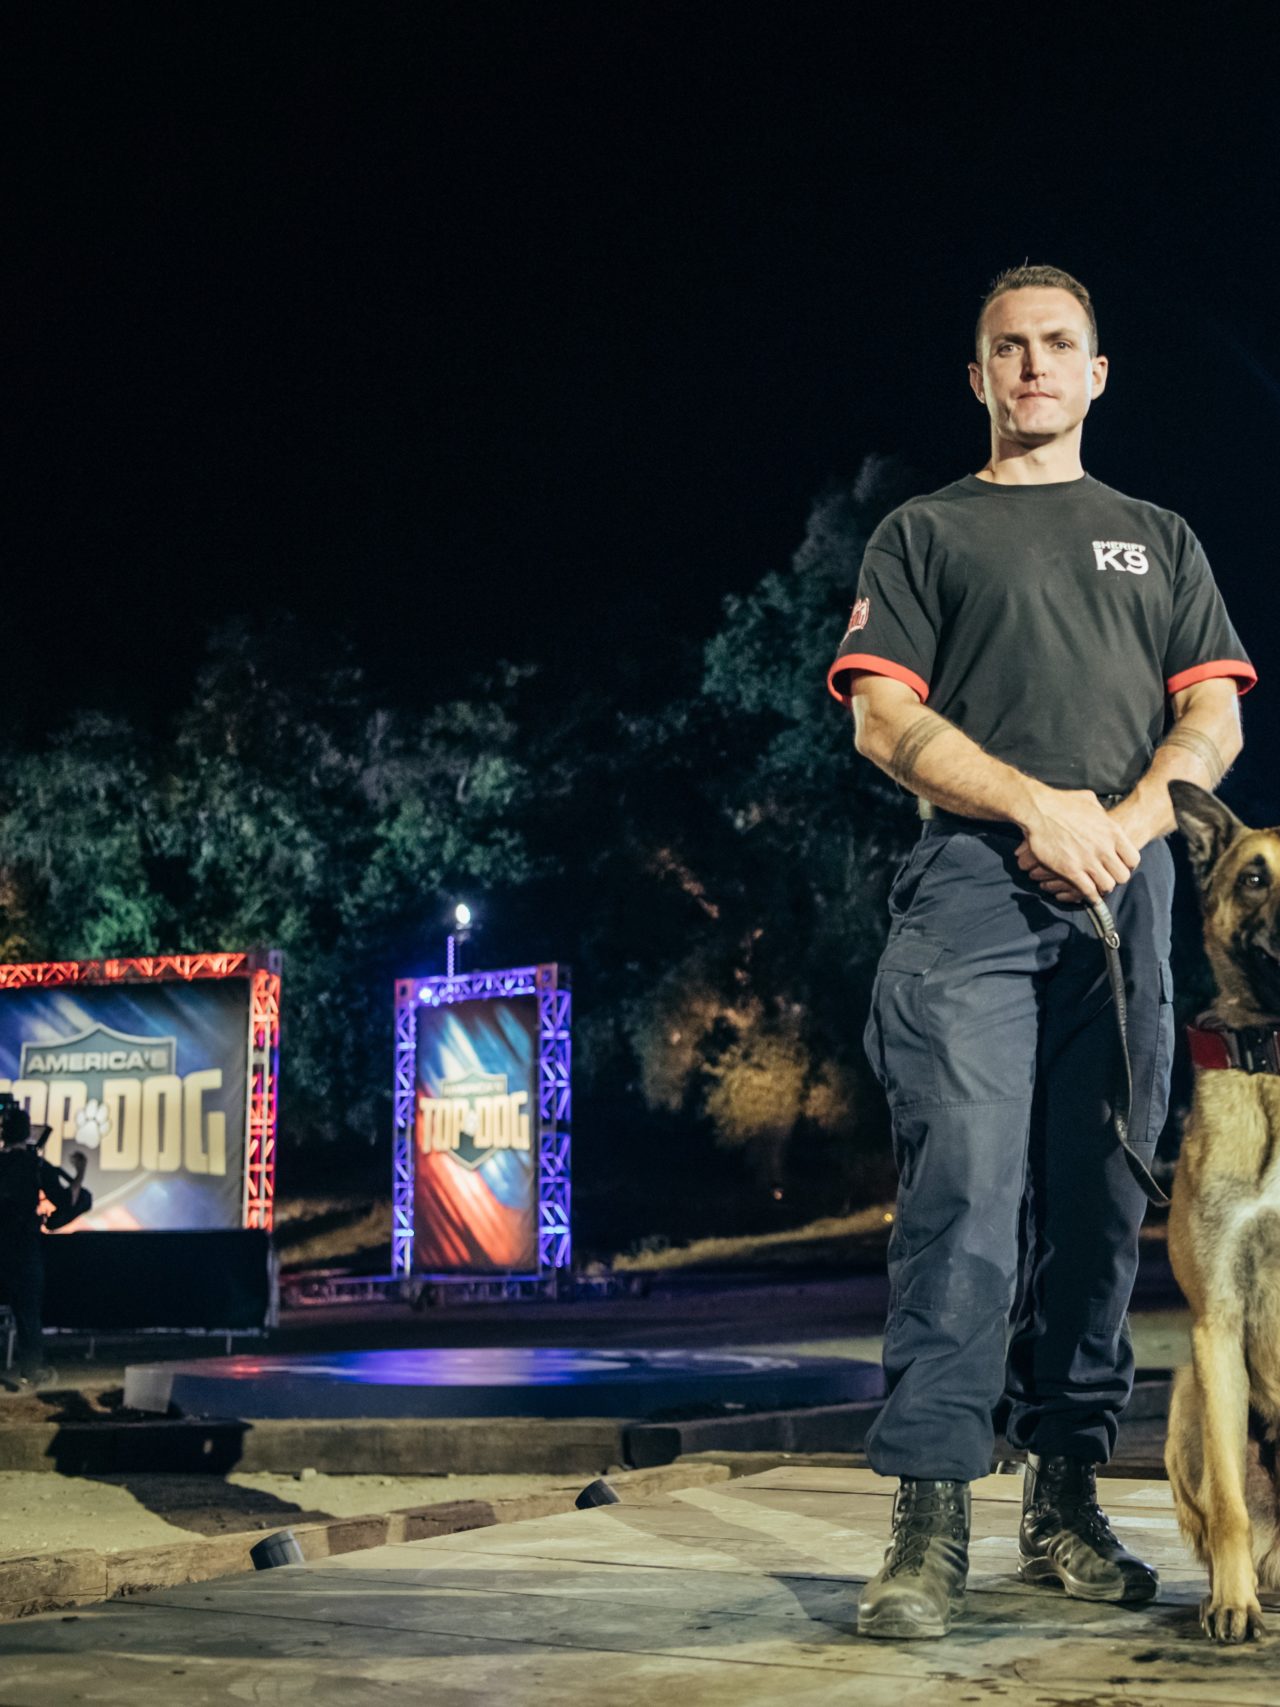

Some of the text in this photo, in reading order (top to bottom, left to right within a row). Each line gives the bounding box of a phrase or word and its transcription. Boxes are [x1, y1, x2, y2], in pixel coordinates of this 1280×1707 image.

[1093, 549, 1149, 575] K9
[26, 1050, 169, 1074] AMERICA'S
[99, 1068, 227, 1176] DOG
[419, 1090, 530, 1154] TOP DOG
